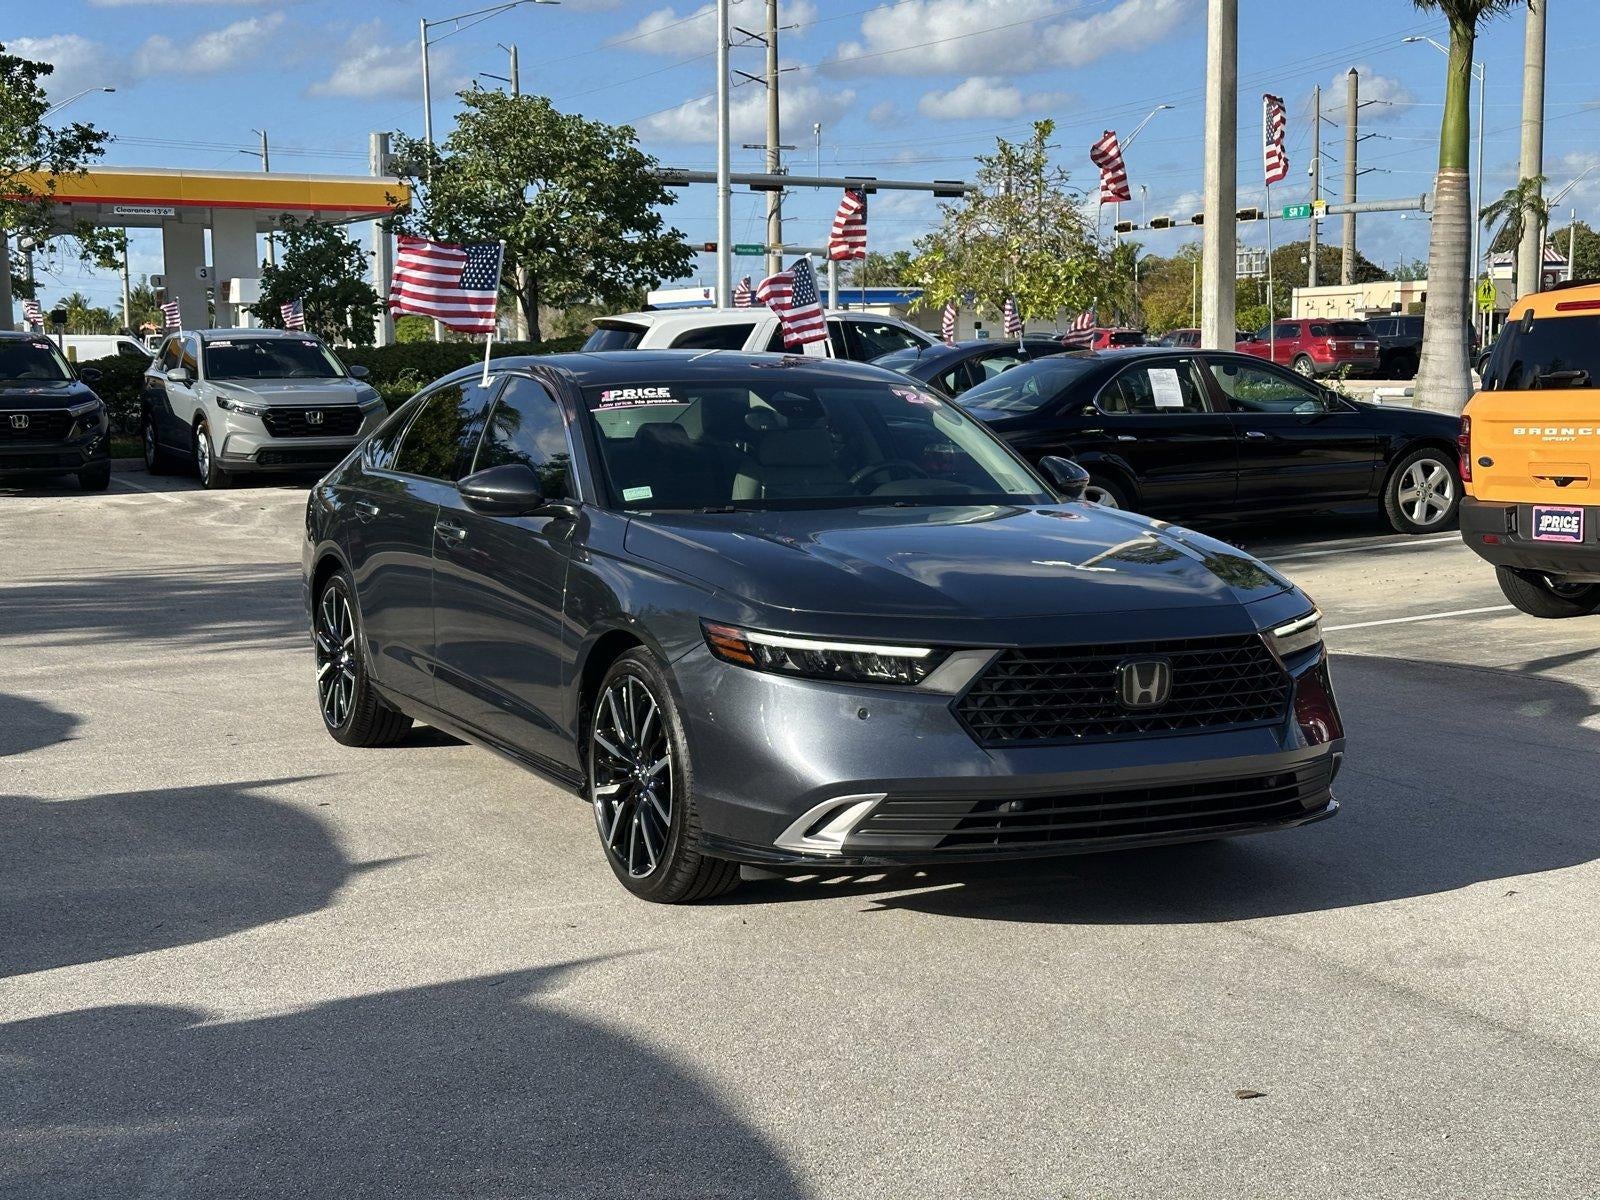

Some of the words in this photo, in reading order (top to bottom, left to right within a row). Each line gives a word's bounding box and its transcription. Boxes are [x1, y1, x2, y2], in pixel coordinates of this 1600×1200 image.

[1289, 207, 1298, 216] SR
[1299, 207, 1305, 216] 7
[200, 268, 207, 278] 3
[157, 277, 161, 286] 1
[601, 387, 670, 400] 1PRICE
[1513, 427, 1600, 435] BRONC
[1540, 515, 1579, 528] 1PRICE
